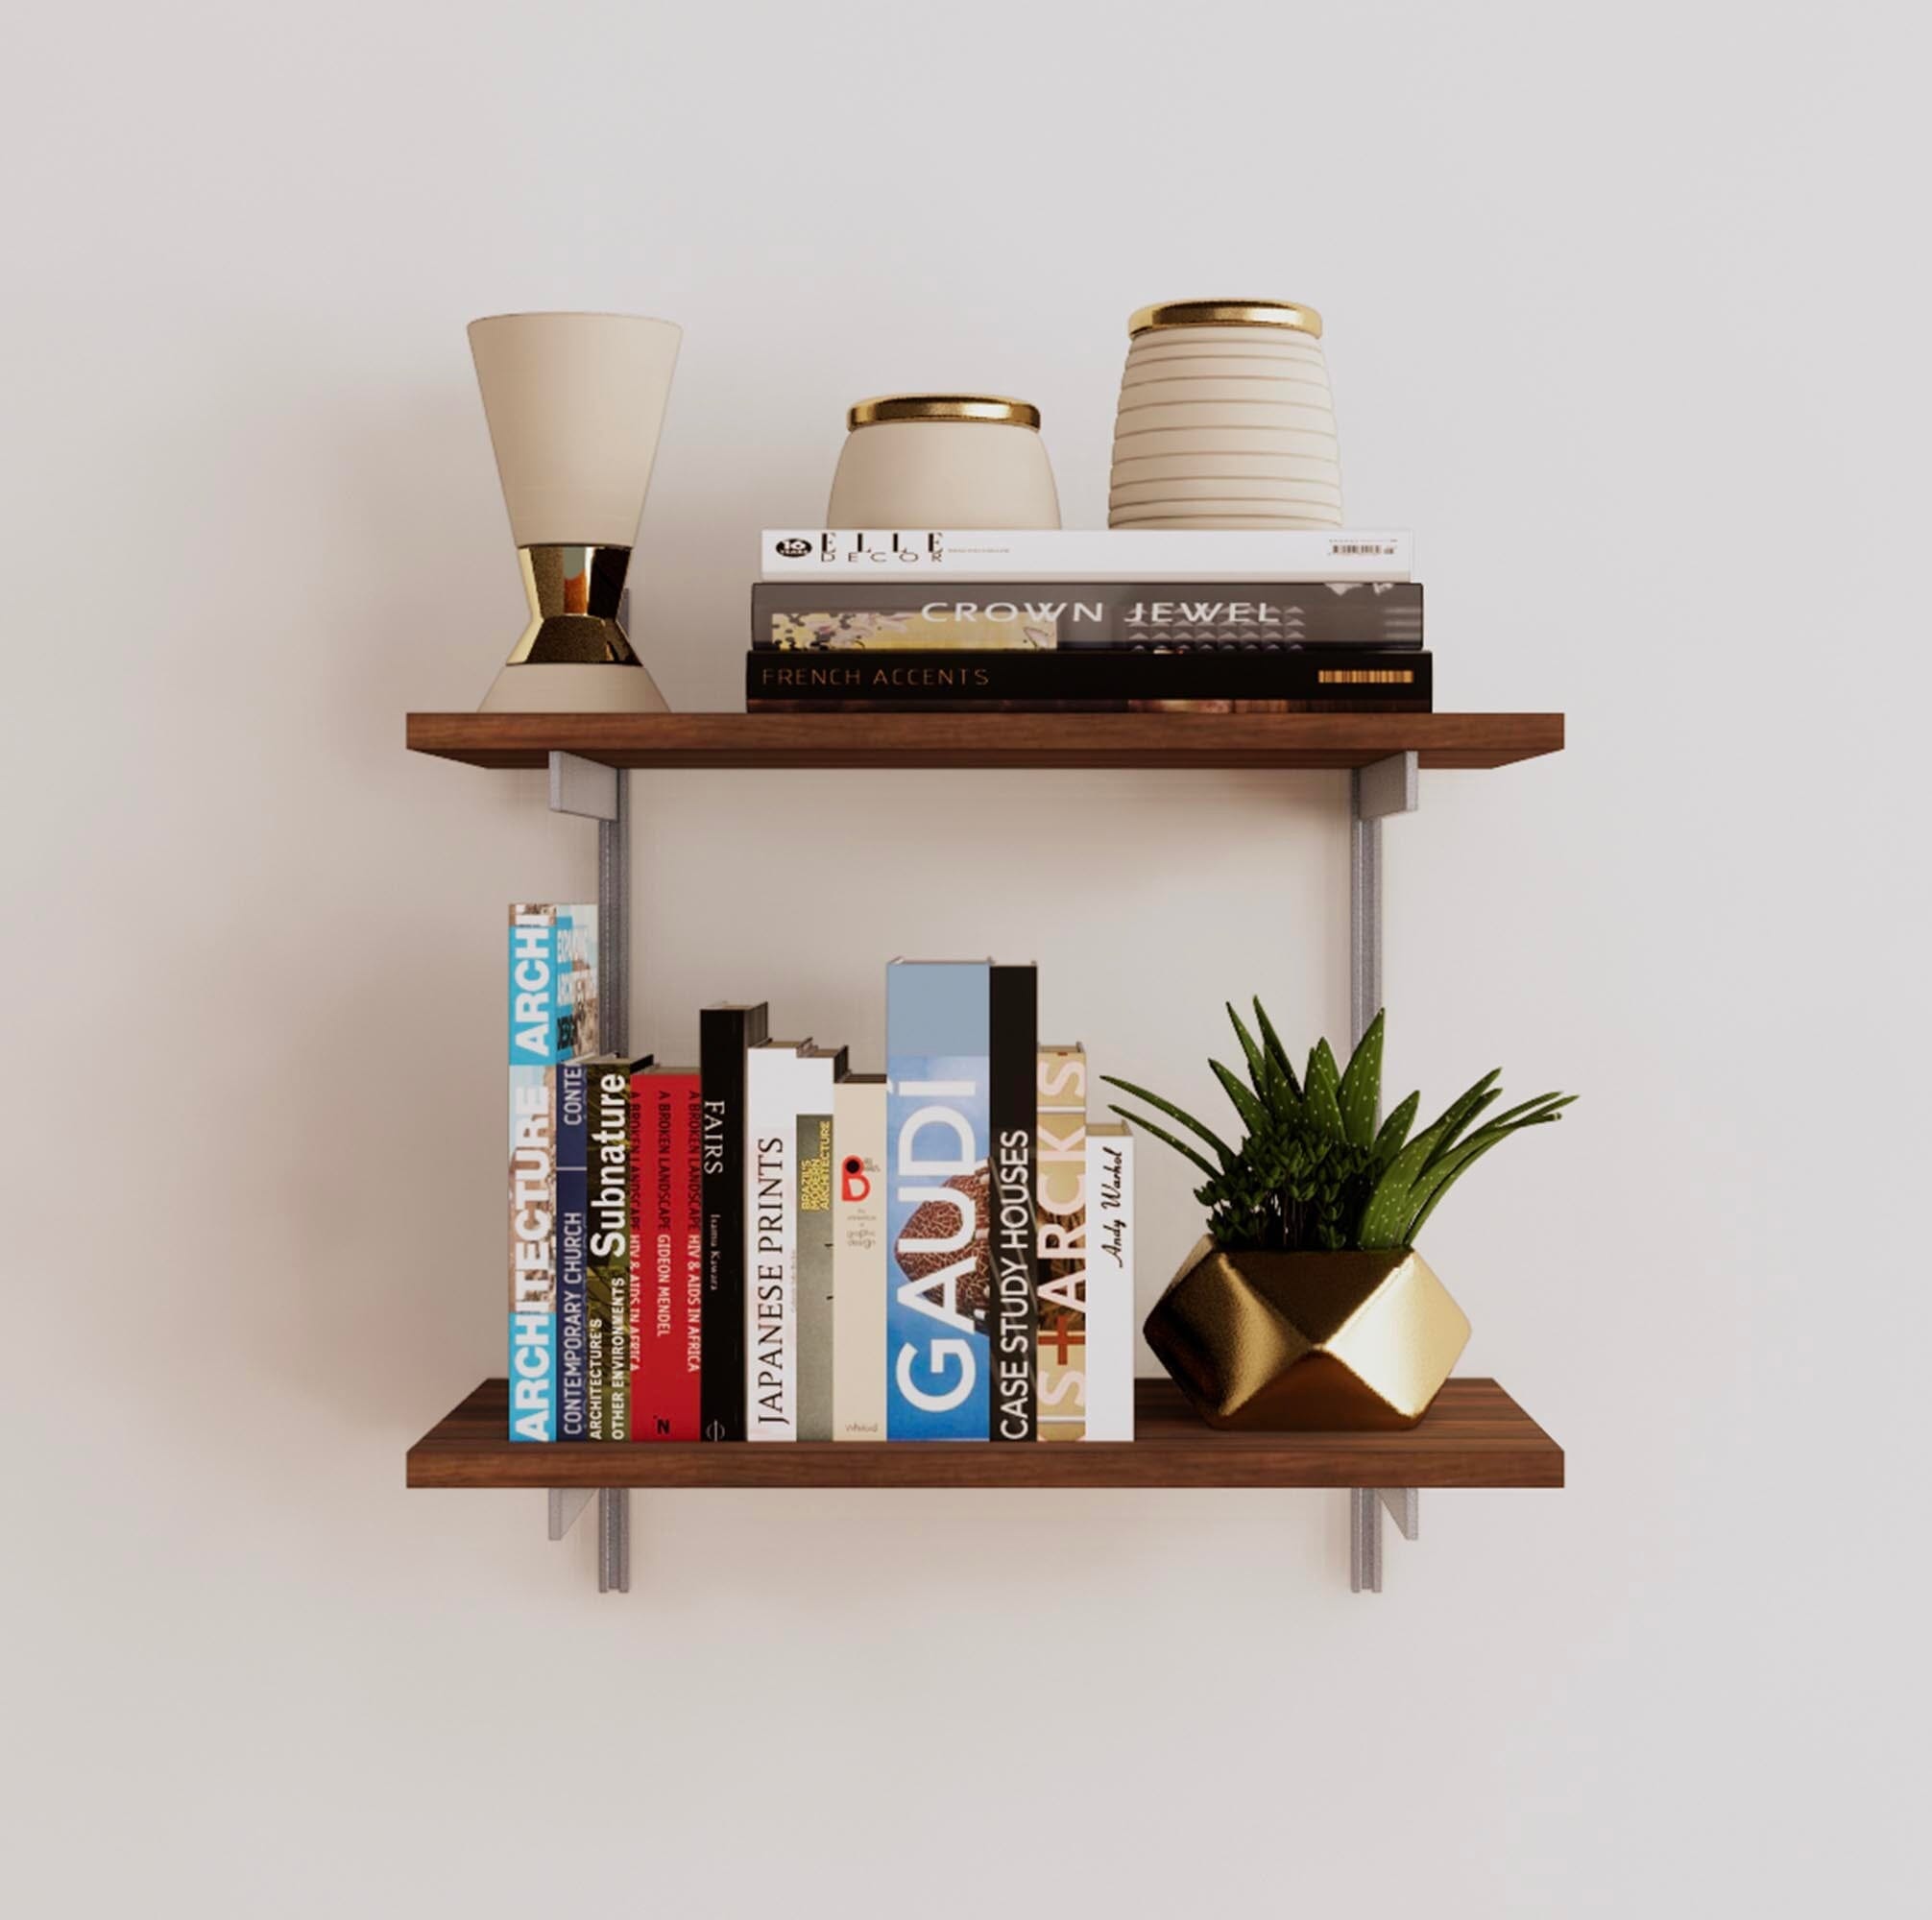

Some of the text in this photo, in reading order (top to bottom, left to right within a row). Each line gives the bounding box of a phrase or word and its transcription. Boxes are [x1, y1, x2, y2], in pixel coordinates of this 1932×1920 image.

[821, 532, 943, 553] ELLE
[821, 552, 942, 563] DECOR
[921, 601, 1282, 623] CROWN JEWEL
[761, 668, 990, 685] FRENCH ACCENTS
[565, 1063, 582, 1125] CONTE
[704, 1101, 725, 1175] FAIRS
[590, 1073, 626, 1258] Subnature
[657, 1090, 671, 1337] A BROKEN LANDSCAPE GIDEON MENDEL
[820, 1120, 831, 1211] ARCHITECTURE
[1100, 1146, 1125, 1268] Andy Warhol
[514, 1086, 550, 1442] ARCHITECTURE
[688, 1090, 701, 1373] A BROKEN LANDSCAPE HIV & AIDS IN AFRICA
[758, 1137, 790, 1425] JAPANESE PRINTS
[1001, 1130, 1028, 1440] CASE STUDY HOUSES
[564, 1212, 582, 1435] CONTEMPORARY CHURCH
[590, 1318, 603, 1440] ARCHITECTURE'S
[612, 1277, 625, 1441] OTHER ENVIRONMENTS
